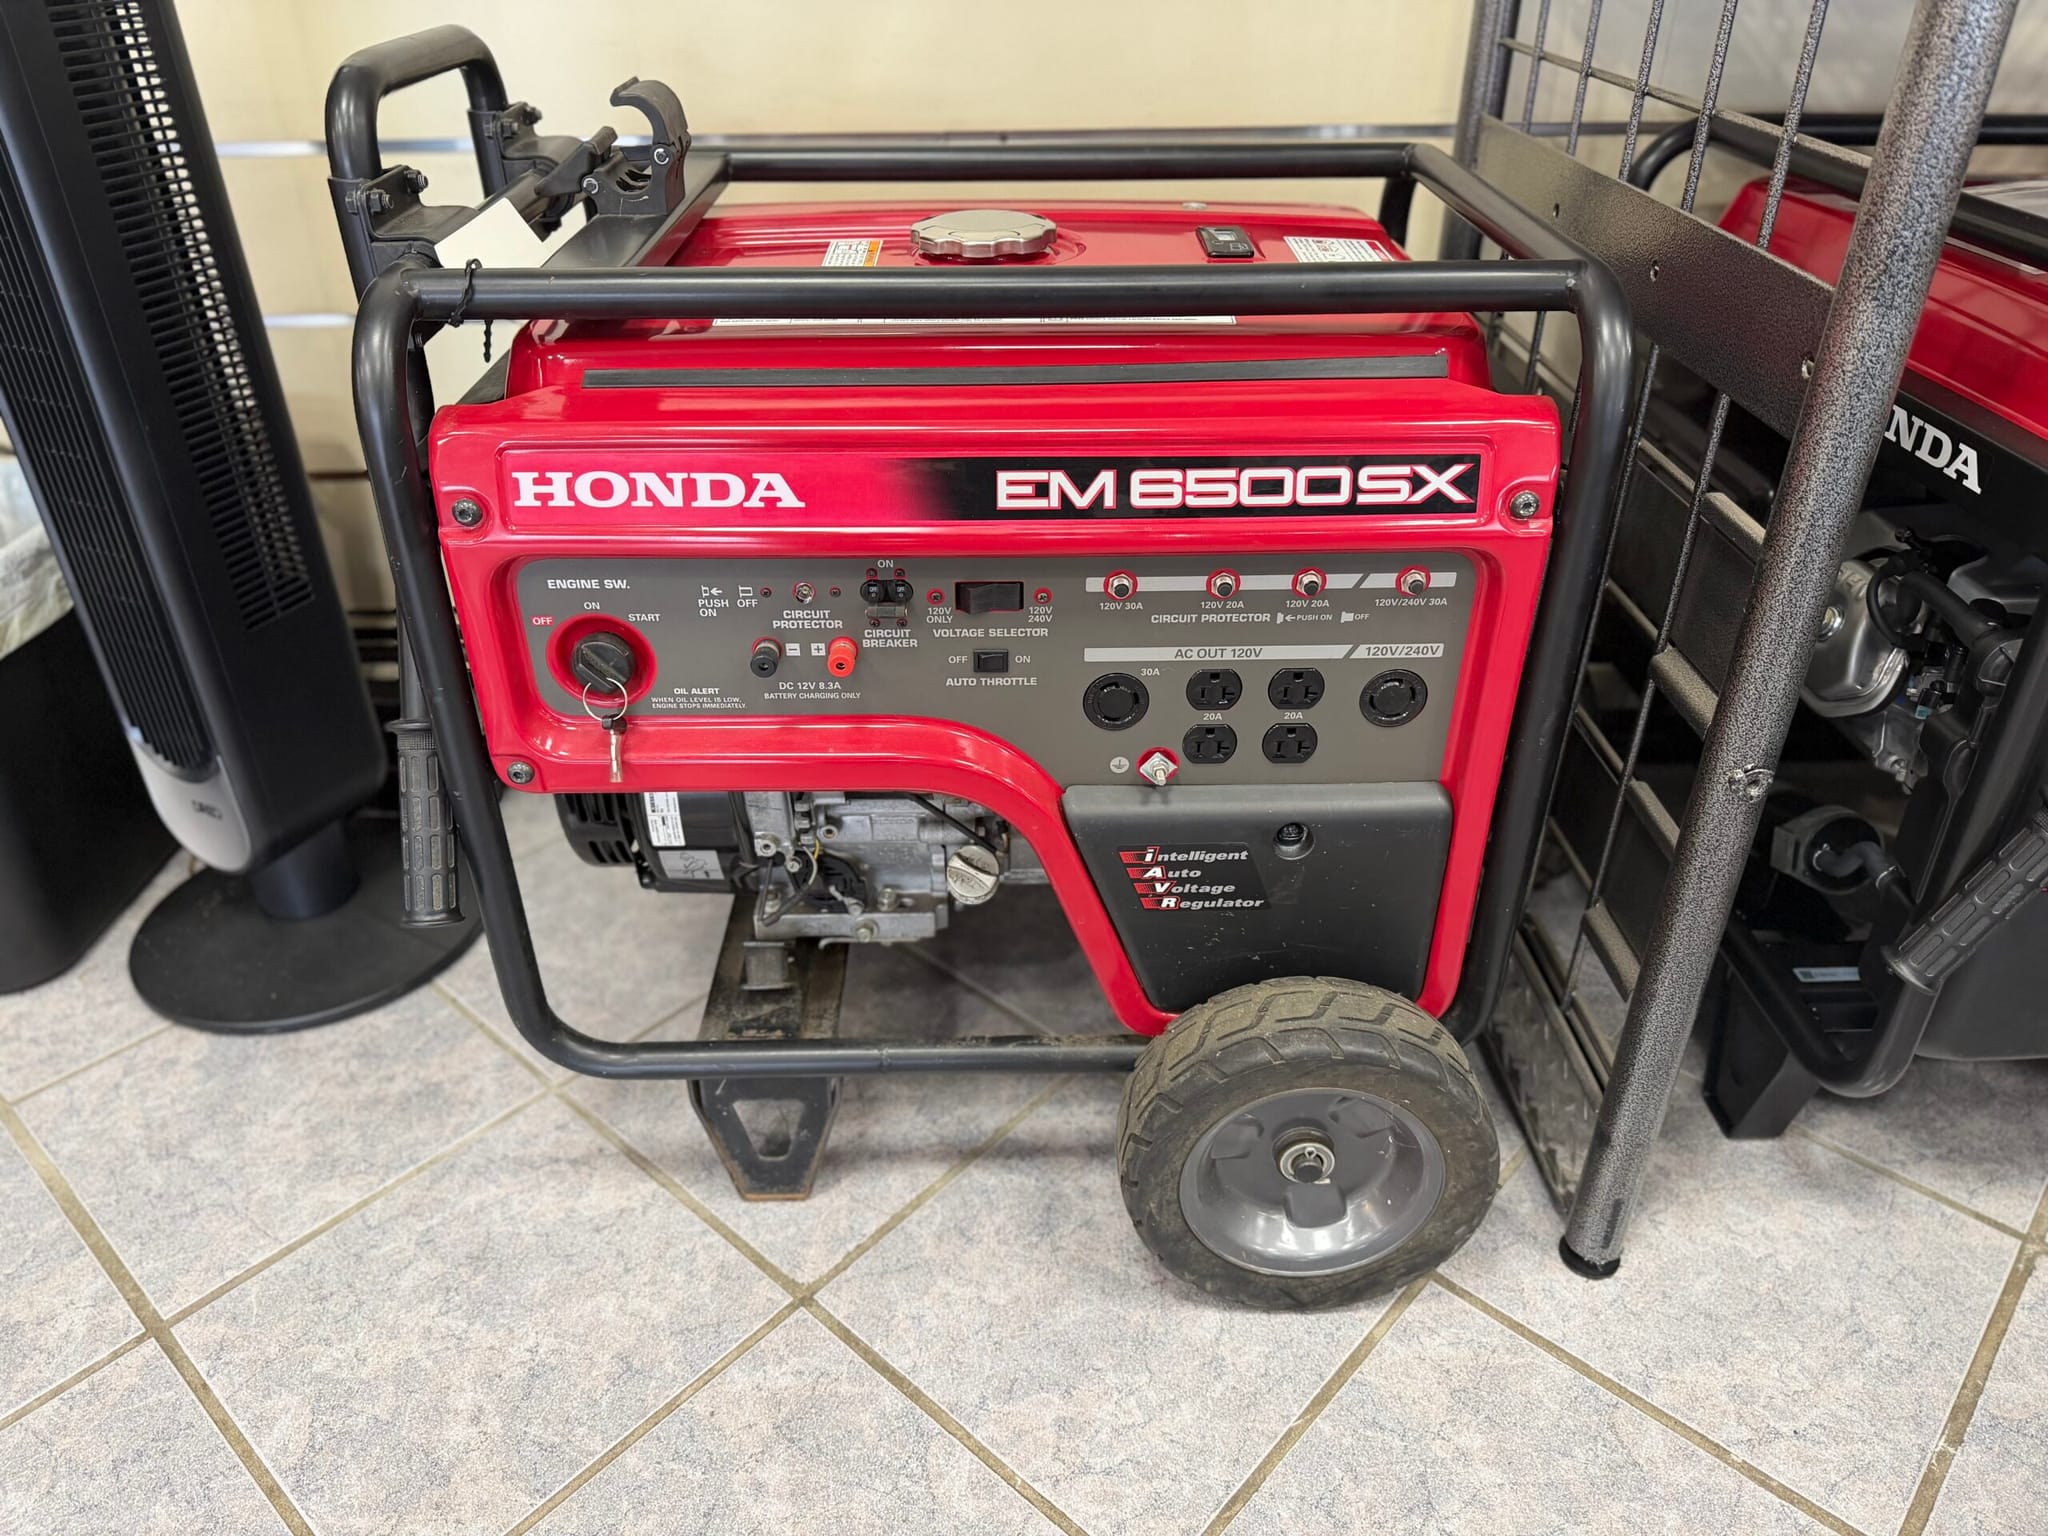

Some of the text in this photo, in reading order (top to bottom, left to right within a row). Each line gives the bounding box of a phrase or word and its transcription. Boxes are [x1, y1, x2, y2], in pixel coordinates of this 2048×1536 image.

[1884, 404, 1982, 495] NDA
[511, 470, 806, 508] HONDA
[996, 463, 1476, 510] EM 6500SX
[877, 559, 894, 568] ON
[547, 579, 630, 589] ENGINE SW.
[583, 602, 600, 610] ON
[698, 599, 729, 608] PUSH
[736, 599, 758, 608] OFF
[1099, 602, 1144, 610] 120V 30A
[1200, 601, 1245, 609] 120V 20A
[1285, 600, 1330, 608] 120V 20A
[1375, 598, 1448, 607] 120V/240V 30A
[699, 609, 717, 617] ON
[783, 610, 831, 619] CIRCUIT
[927, 607, 952, 615] 120V
[1028, 606, 1053, 615] 120V
[532, 616, 553, 626] OFF
[628, 613, 660, 622] START
[926, 615, 953, 624] ONLY
[1028, 615, 1053, 623] 240V
[1151, 614, 1198, 624] CIRCUIT
[1201, 613, 1271, 623] PROTECTOR
[772, 620, 844, 629] PROTECTOR
[864, 629, 911, 638] CIRCUIT
[933, 627, 1049, 638] VOLTAGE SELECTOR
[862, 639, 918, 648] BREAKER
[1174, 648, 1263, 660] AC OUT 120V
[1365, 645, 1440, 657] 120V/240V
[948, 656, 968, 664] OFF
[1014, 655, 1031, 664] ON
[1140, 668, 1160, 676] 30A
[779, 682, 841, 690] DC 12V 8.3A
[945, 677, 1038, 687] AUTO THROTTLE
[691, 687, 720, 695] ALERT
[764, 692, 797, 700] BATTERY
[799, 692, 839, 700] CHARGING
[1203, 713, 1223, 721] 20A
[1284, 712, 1303, 720] 20A
[1144, 849, 1249, 863] intelligent
[1142, 866, 1202, 878] Auto
[1154, 882, 1236, 895] Voltage
[1160, 897, 1265, 910] Regulator
